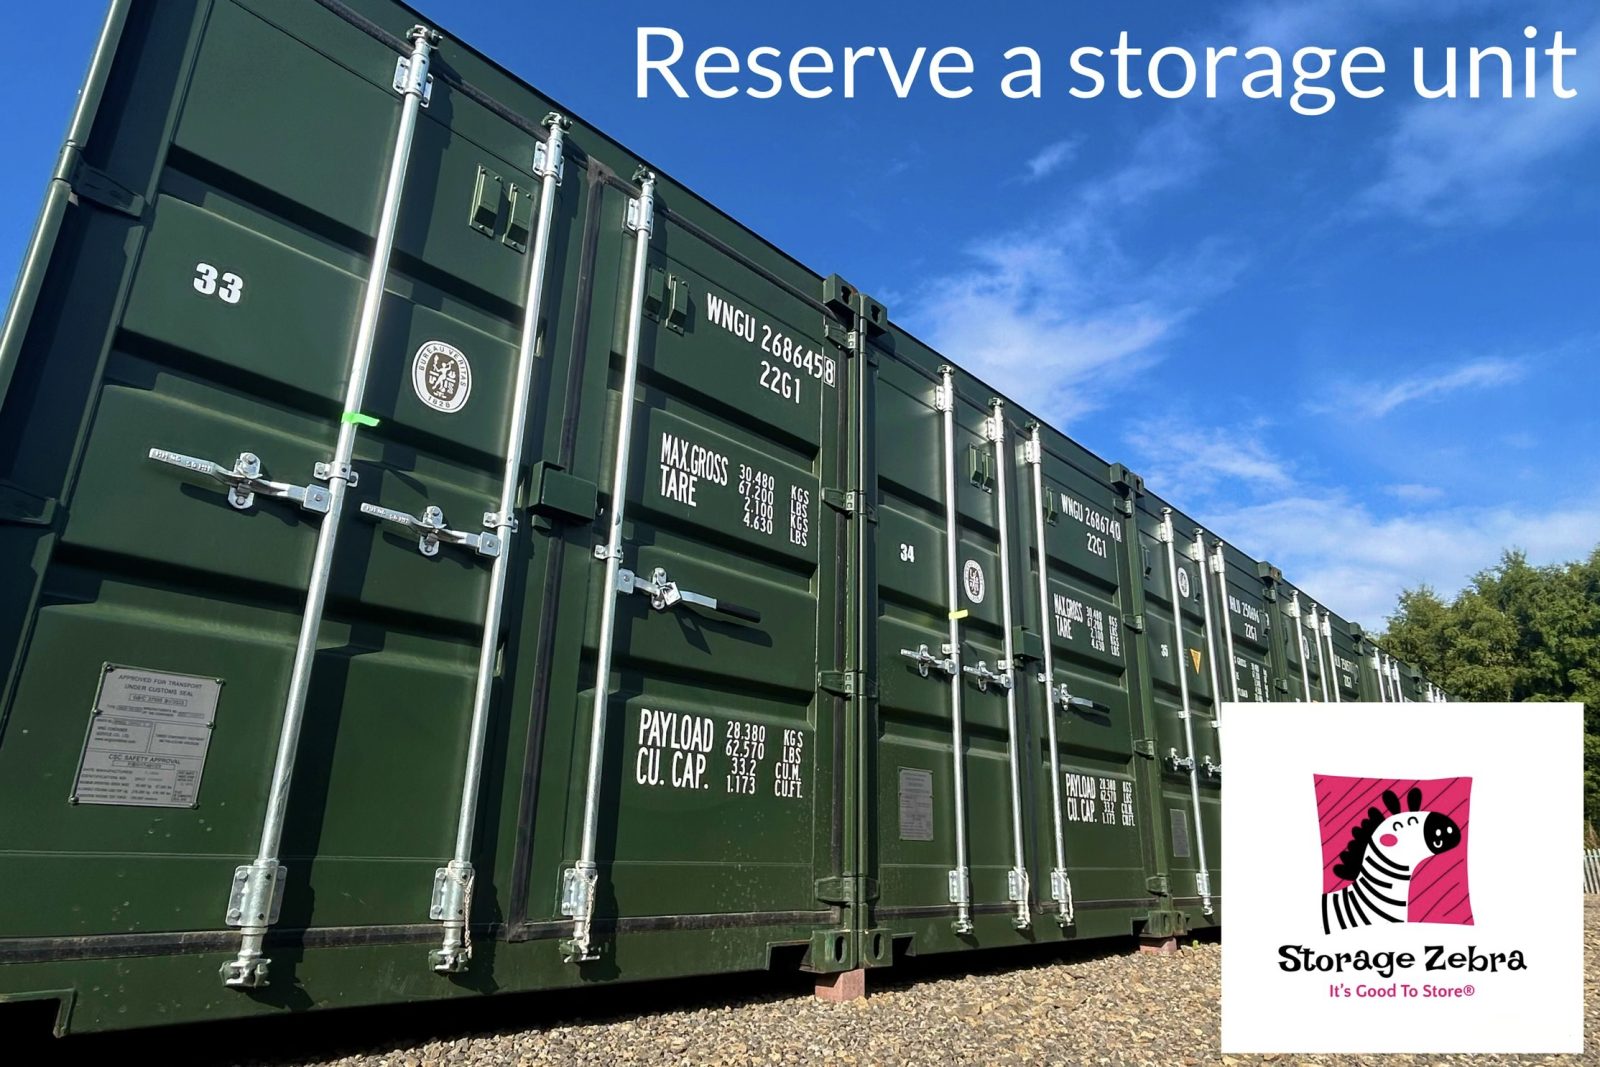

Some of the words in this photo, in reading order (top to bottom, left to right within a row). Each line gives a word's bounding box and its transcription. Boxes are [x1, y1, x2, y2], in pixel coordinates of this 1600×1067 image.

[193, 262, 244, 304] 33
[707, 292, 755, 342] WNGU
[419, 345, 445, 371] BUREAU
[448, 349, 467, 387] VERITAS
[760, 360, 800, 404] 22G1
[660, 432, 728, 486] MAX.GROSS
[660, 464, 698, 507] TARE
[738, 480, 774, 505] 67.200
[790, 500, 808, 518] LBS
[739, 464, 775, 491] 30.480
[791, 485, 809, 505] KGS
[744, 497, 774, 520] 2.100
[790, 514, 808, 533] KGS
[1060, 493, 1083, 522] WNGU
[743, 512, 773, 535] 4.630
[790, 528, 808, 547] LBS
[900, 543, 915, 562] 34
[1086, 532, 1107, 558] 22G1
[1055, 614, 1073, 640] TARE
[118, 675, 152, 683] APPROVED
[168, 680, 202, 689] TRANSPORT
[148, 686, 178, 695] CUSTOMS
[638, 708, 714, 753] PAYLOAD
[726, 720, 766, 743] 28.380
[783, 729, 803, 748] KGS
[151, 757, 180, 765] APPROVAL
[725, 741, 765, 760] 62.570
[783, 745, 801, 764] LBS
[731, 757, 756, 777] 33.2
[636, 747, 665, 786] CU.
[671, 750, 709, 790] CAP.
[727, 775, 756, 795] 1.173
[1065, 773, 1096, 799] PAYLOAD
[1081, 799, 1097, 822] CAP.
